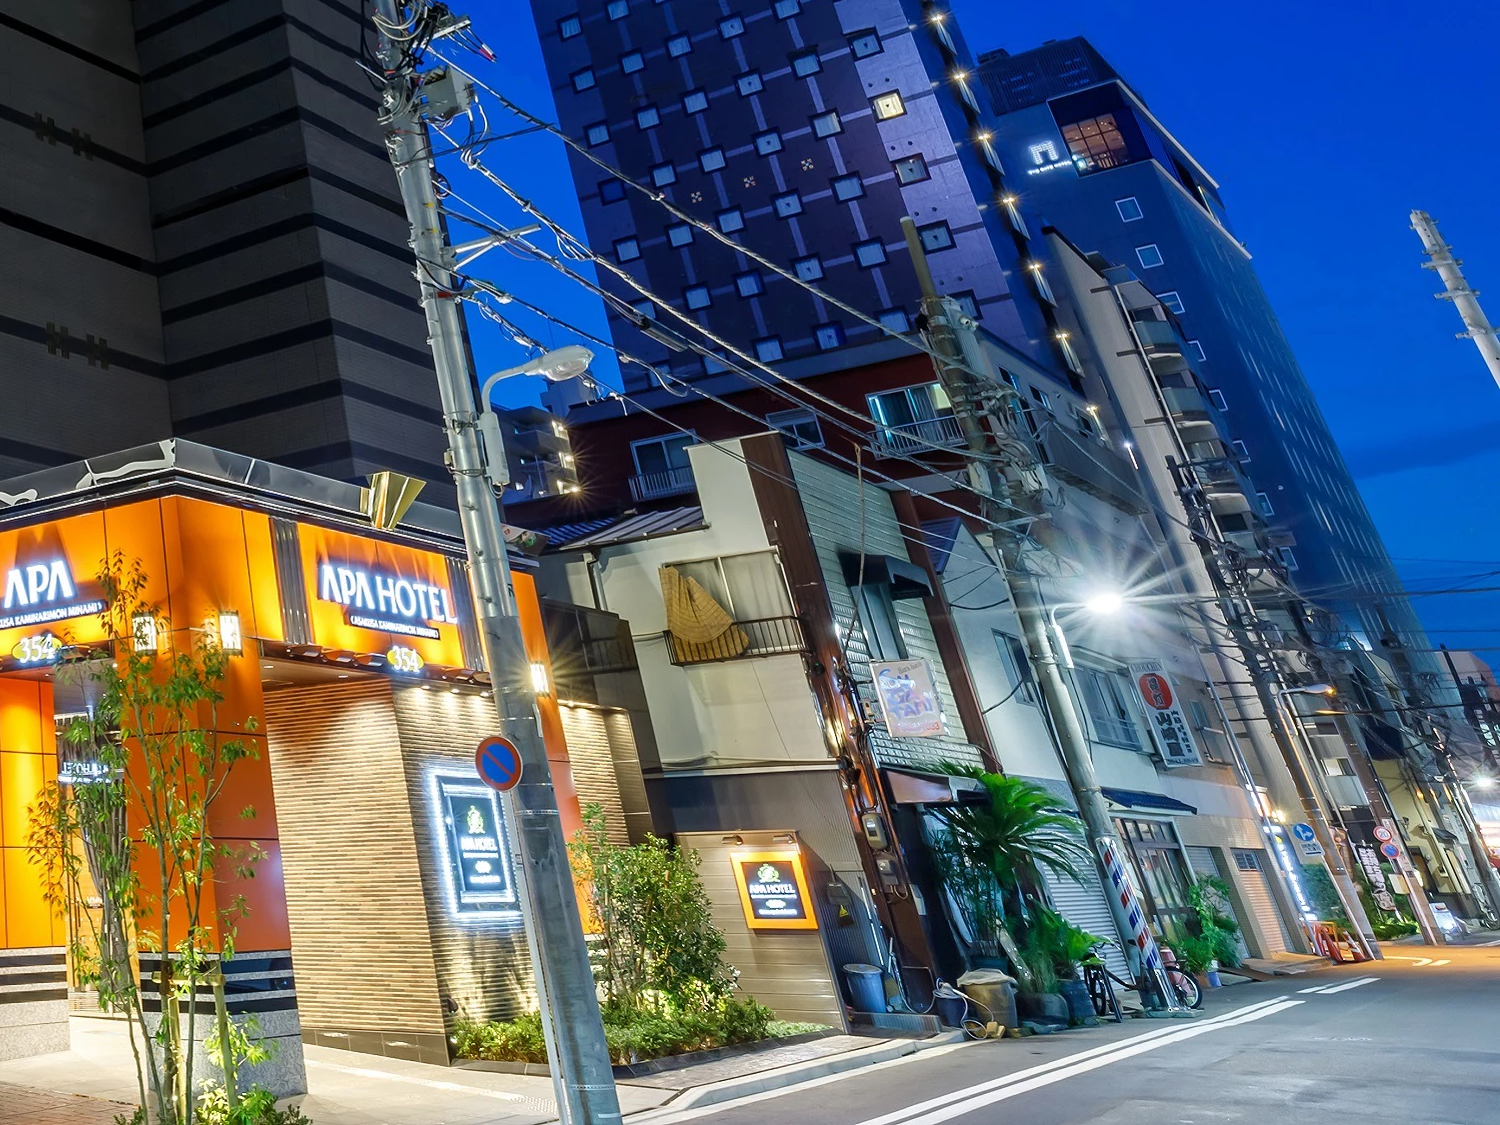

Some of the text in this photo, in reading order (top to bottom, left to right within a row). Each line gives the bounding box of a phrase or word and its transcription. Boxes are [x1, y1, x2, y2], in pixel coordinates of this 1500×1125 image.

[3, 560, 74, 609] APA
[322, 564, 459, 625] APA HOTEL
[19, 633, 57, 664] 354
[392, 645, 420, 673] 354
[766, 883, 796, 894] HOTEL
